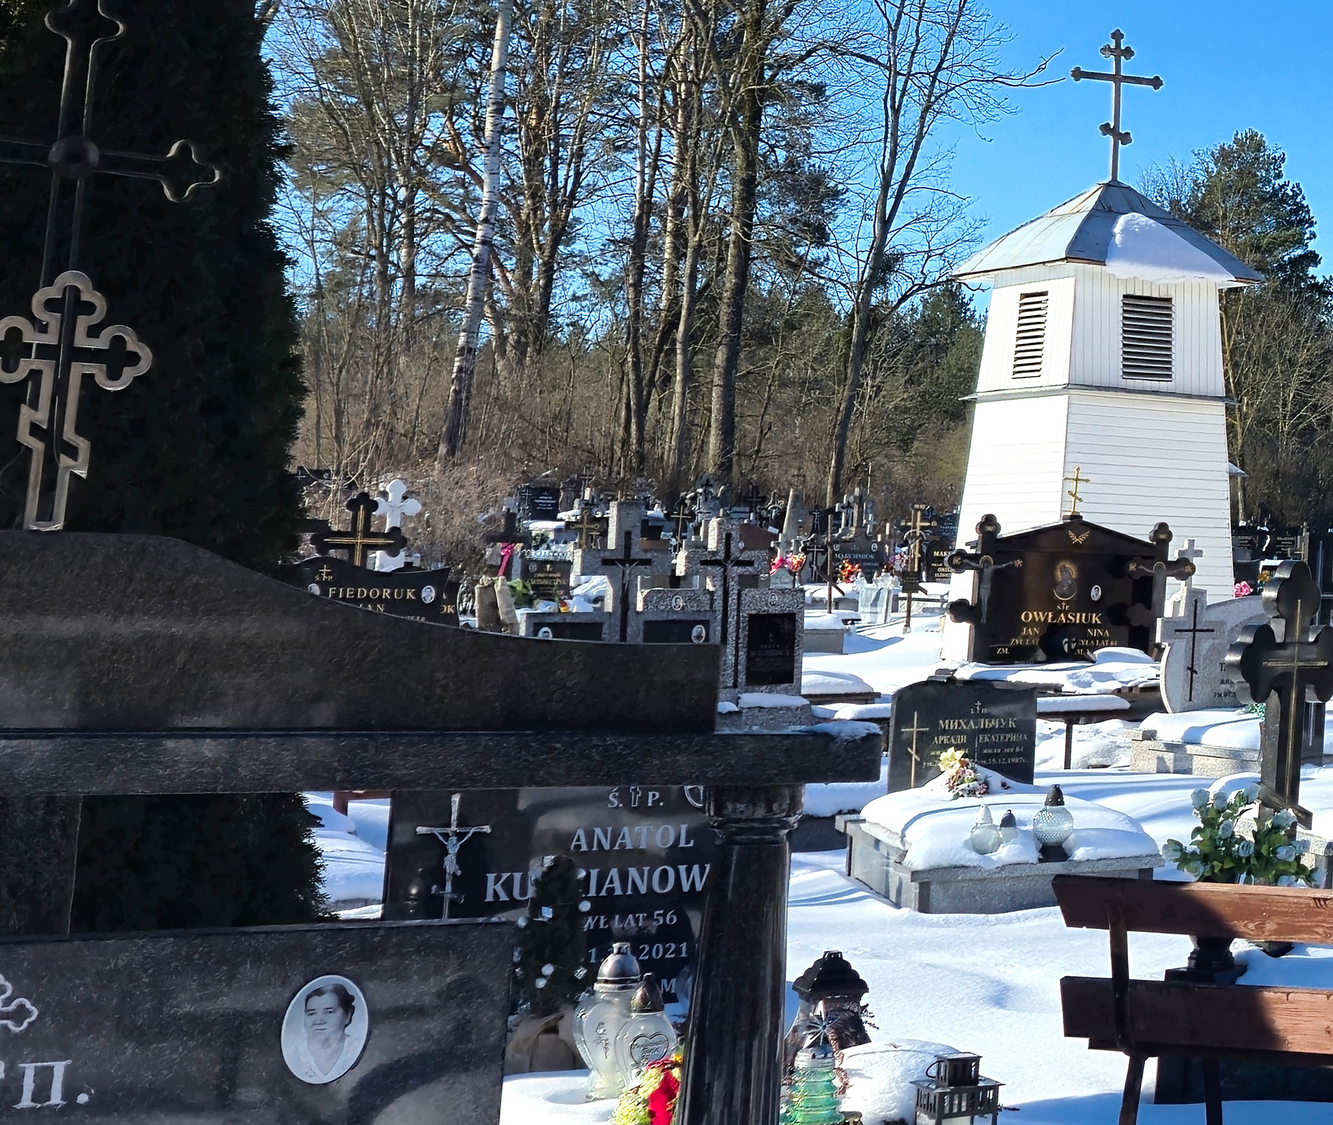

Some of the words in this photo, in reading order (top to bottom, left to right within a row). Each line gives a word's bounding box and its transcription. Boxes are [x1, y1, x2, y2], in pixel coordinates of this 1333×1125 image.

[328, 587, 416, 600] FIEDORUK
[1020, 610, 1102, 624] OWŁASIUK
[1021, 627, 1040, 636] JAN
[1086, 628, 1110, 638] NINA
[938, 717, 1018, 731] МИХАЛЬЧУК
[979, 733, 1029, 743] ЕКАТЕРИНА
[570, 824, 695, 853] ANATOL
[483, 863, 711, 903] KUIANOW
[614, 913, 647, 929] LAT
[652, 909, 678, 926] 56
[13, 1059, 90, 1111] П.
